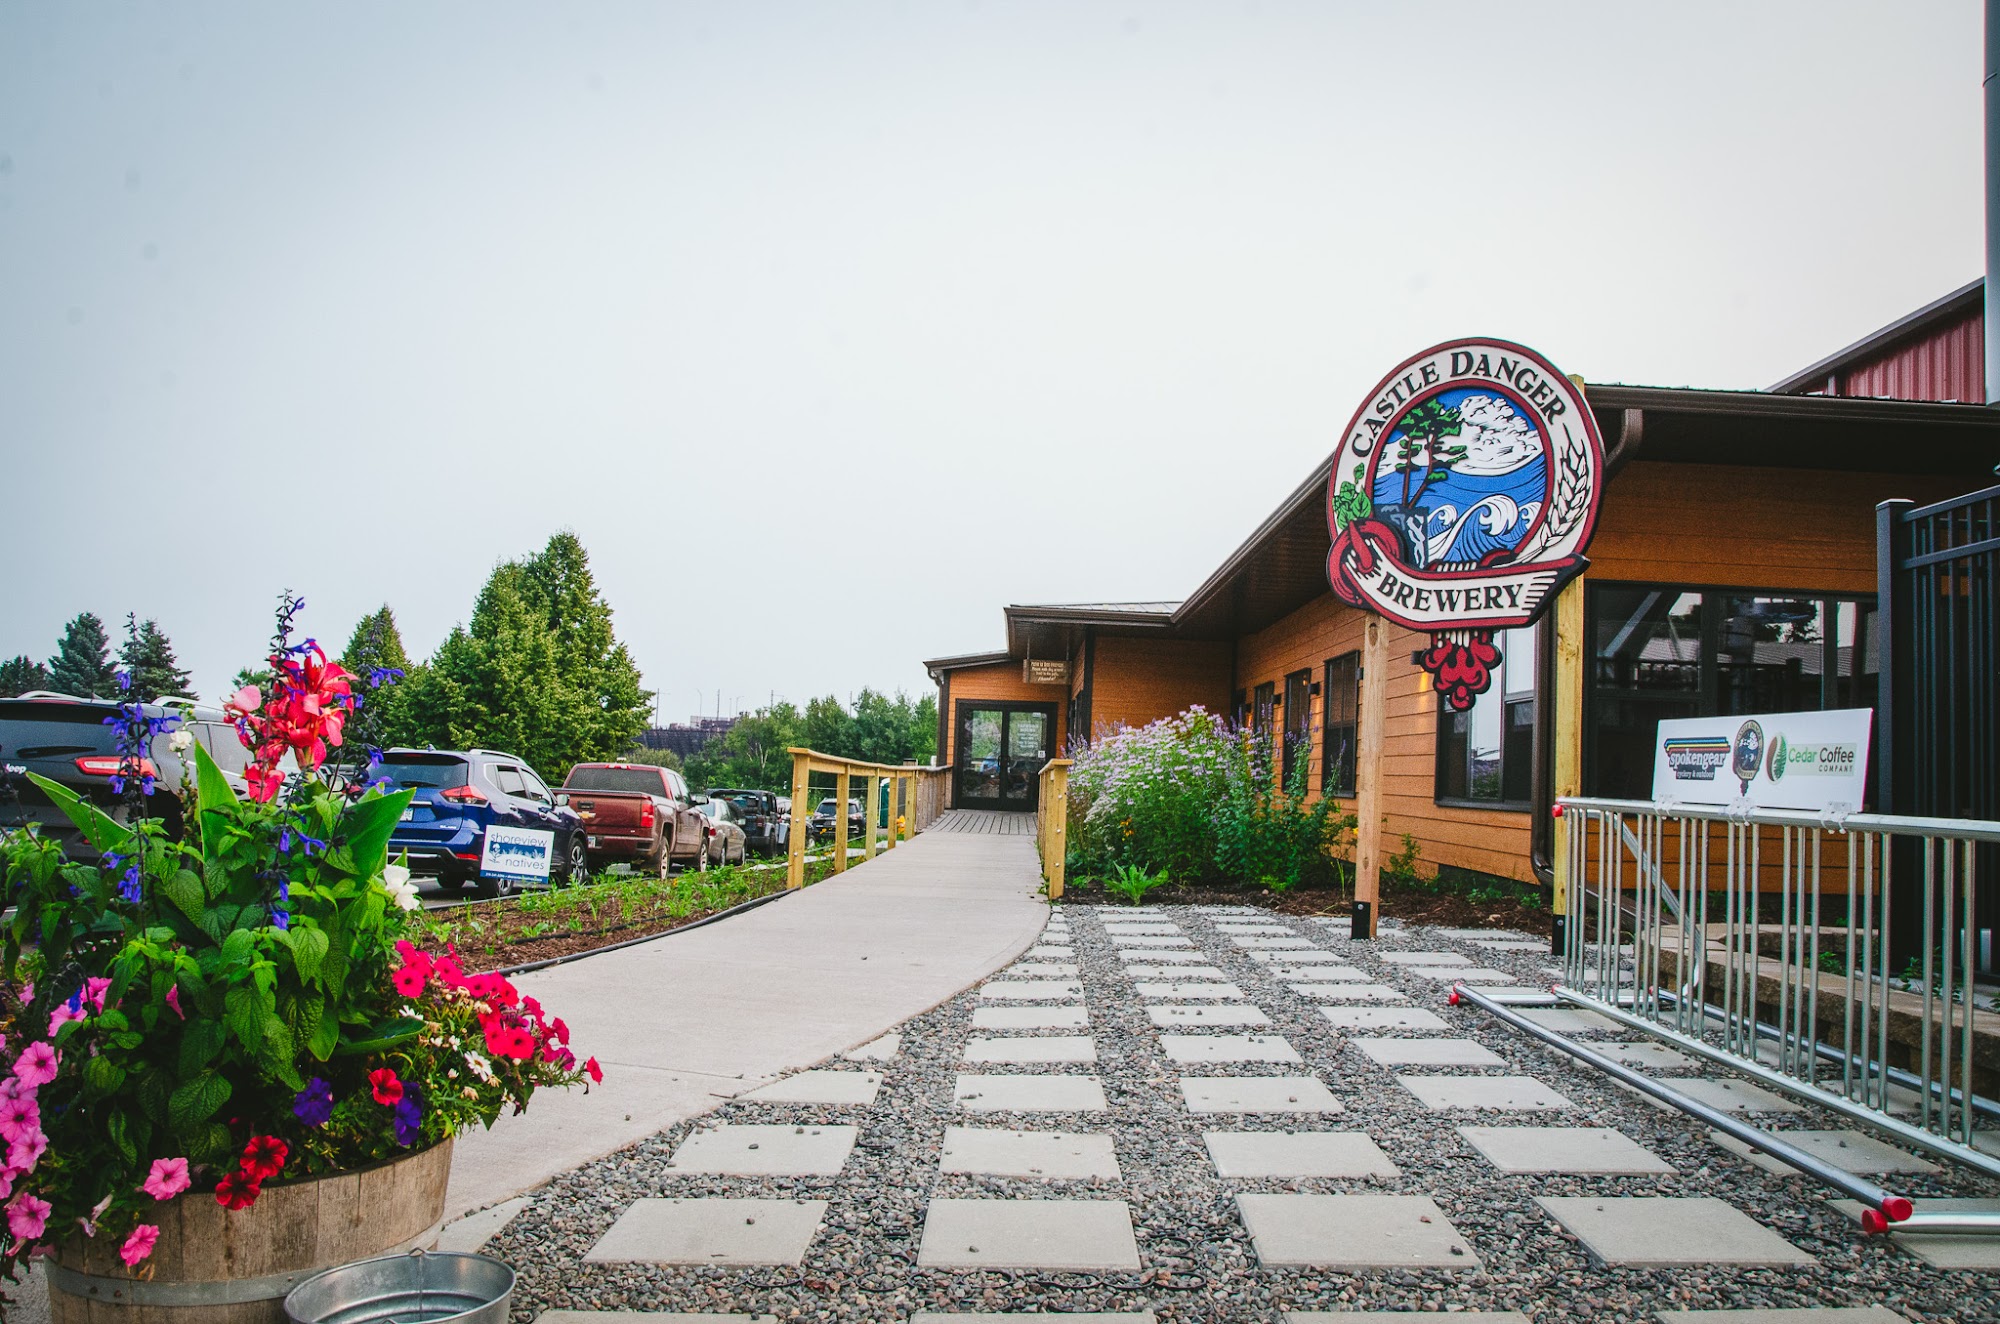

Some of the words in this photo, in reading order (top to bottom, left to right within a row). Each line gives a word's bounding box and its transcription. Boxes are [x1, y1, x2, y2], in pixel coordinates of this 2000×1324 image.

[1352, 361, 1440, 458] CASTLE
[1450, 350, 1566, 425] DANGER
[1377, 571, 1524, 613] BREWERY
[1670, 748, 1726, 770] spokengear
[1788, 747, 1817, 763] Cedar
[1820, 746, 1854, 763] Coffee
[1696, 770, 1714, 778] outdoor
[1818, 764, 1853, 772] COMPANY
[491, 833, 548, 846] shoreview
[505, 858, 545, 870] natives
